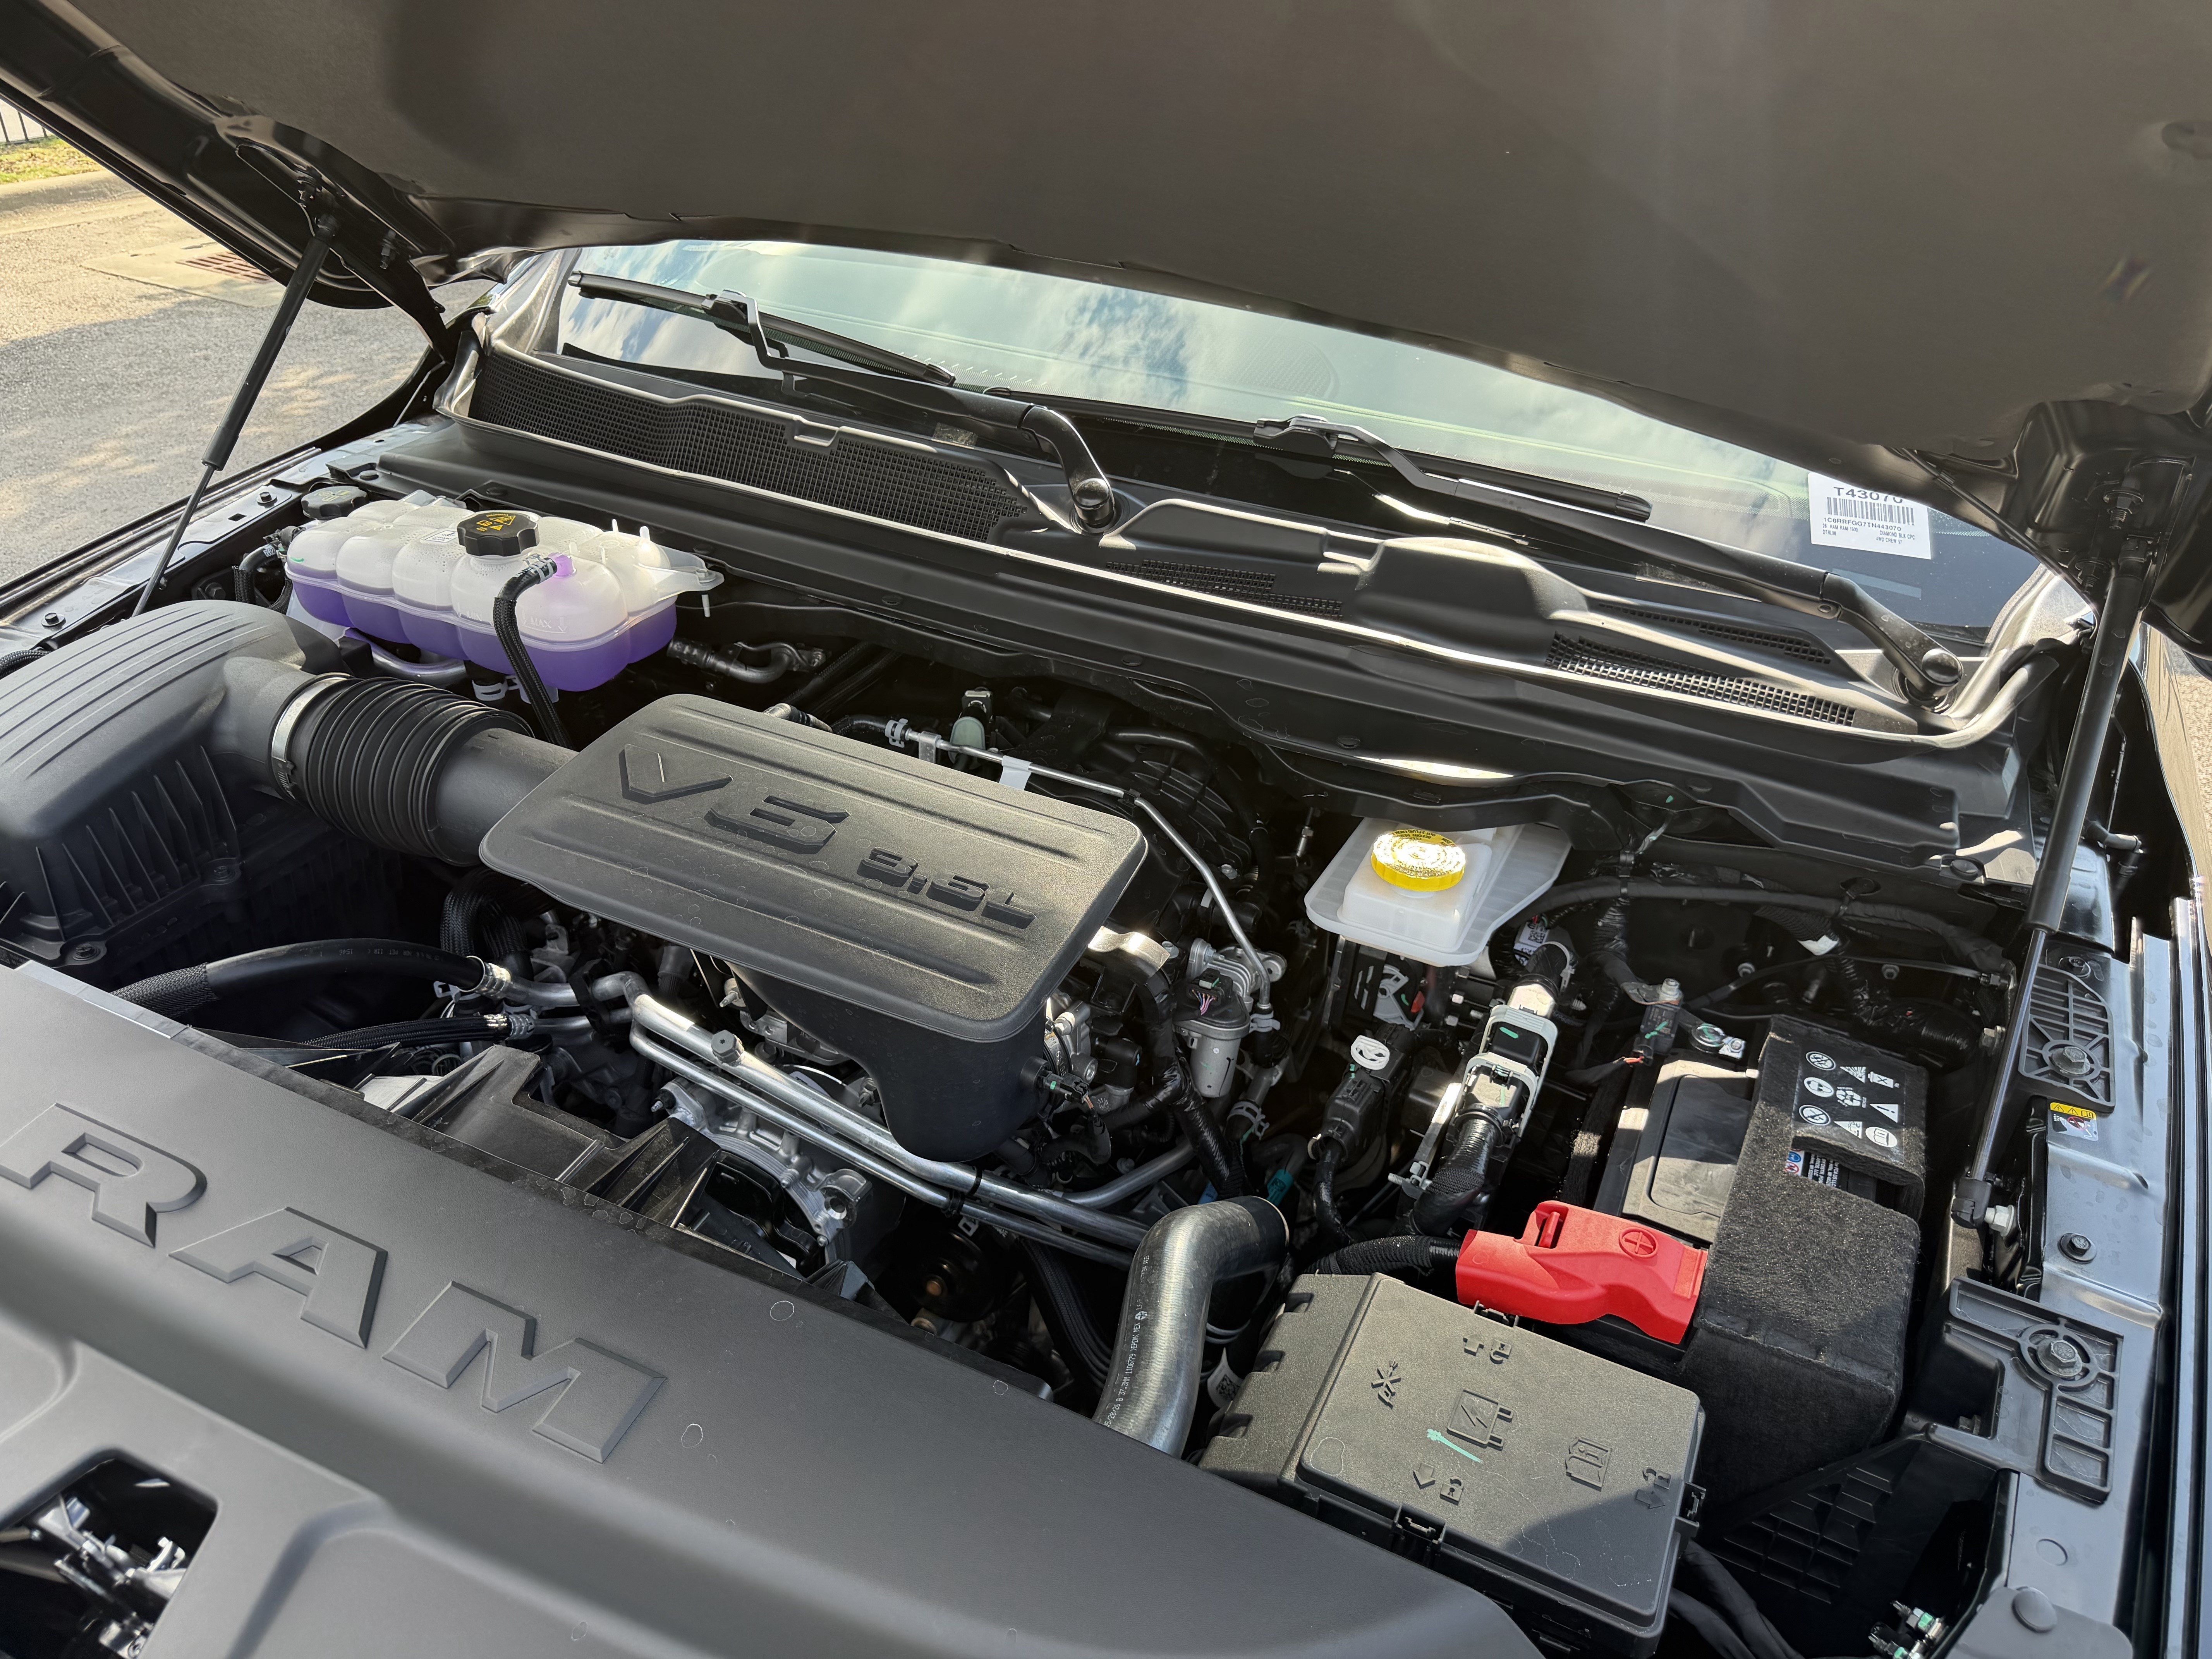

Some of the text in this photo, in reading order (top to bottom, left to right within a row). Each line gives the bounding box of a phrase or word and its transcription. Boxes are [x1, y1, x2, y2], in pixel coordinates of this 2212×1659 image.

[531, 616, 552, 629] MAX
[619, 743, 850, 854] V6
[856, 847, 1037, 929] 3.6L
[0, 1102, 668, 1464] RAM
